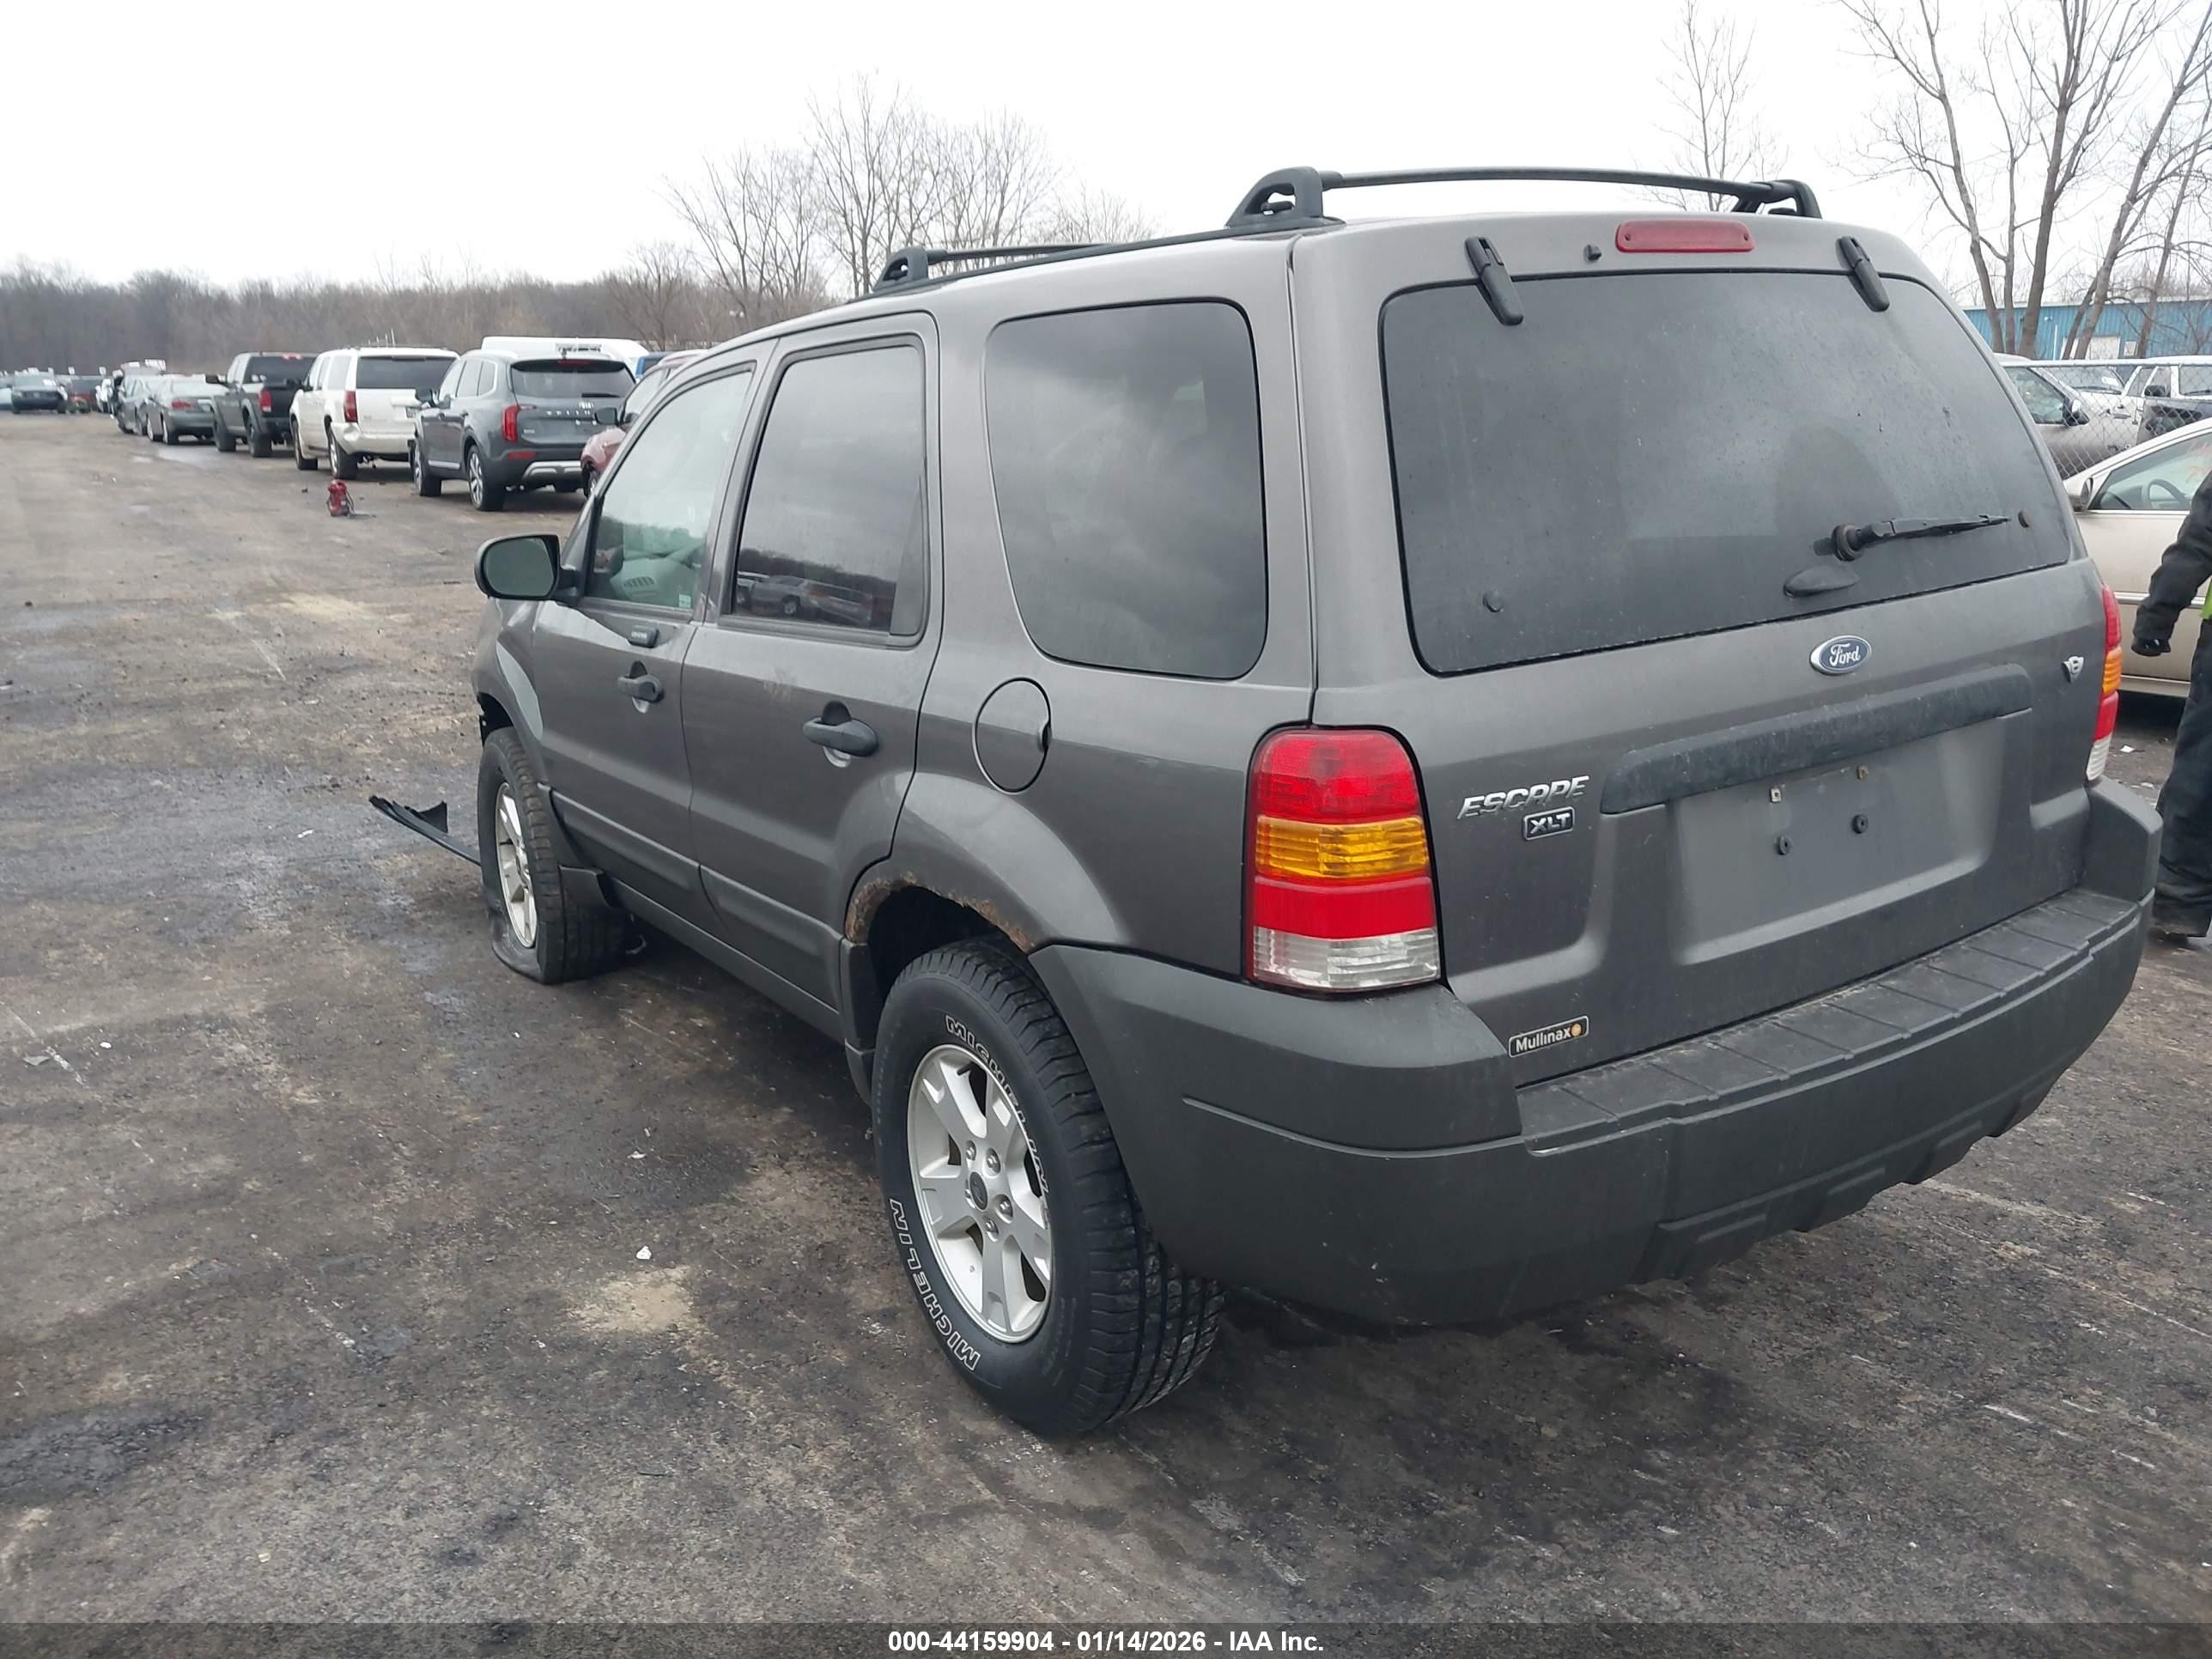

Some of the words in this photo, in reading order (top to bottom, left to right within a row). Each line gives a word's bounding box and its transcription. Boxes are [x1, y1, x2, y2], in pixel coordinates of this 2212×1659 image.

[1828, 642, 1862, 667] Ford
[1456, 775, 1589, 820] ESCAPE
[1529, 812, 1571, 835] XLT
[1516, 1026, 1571, 1054] Mullinax
[889, 1198, 981, 1371] MICHELIN
